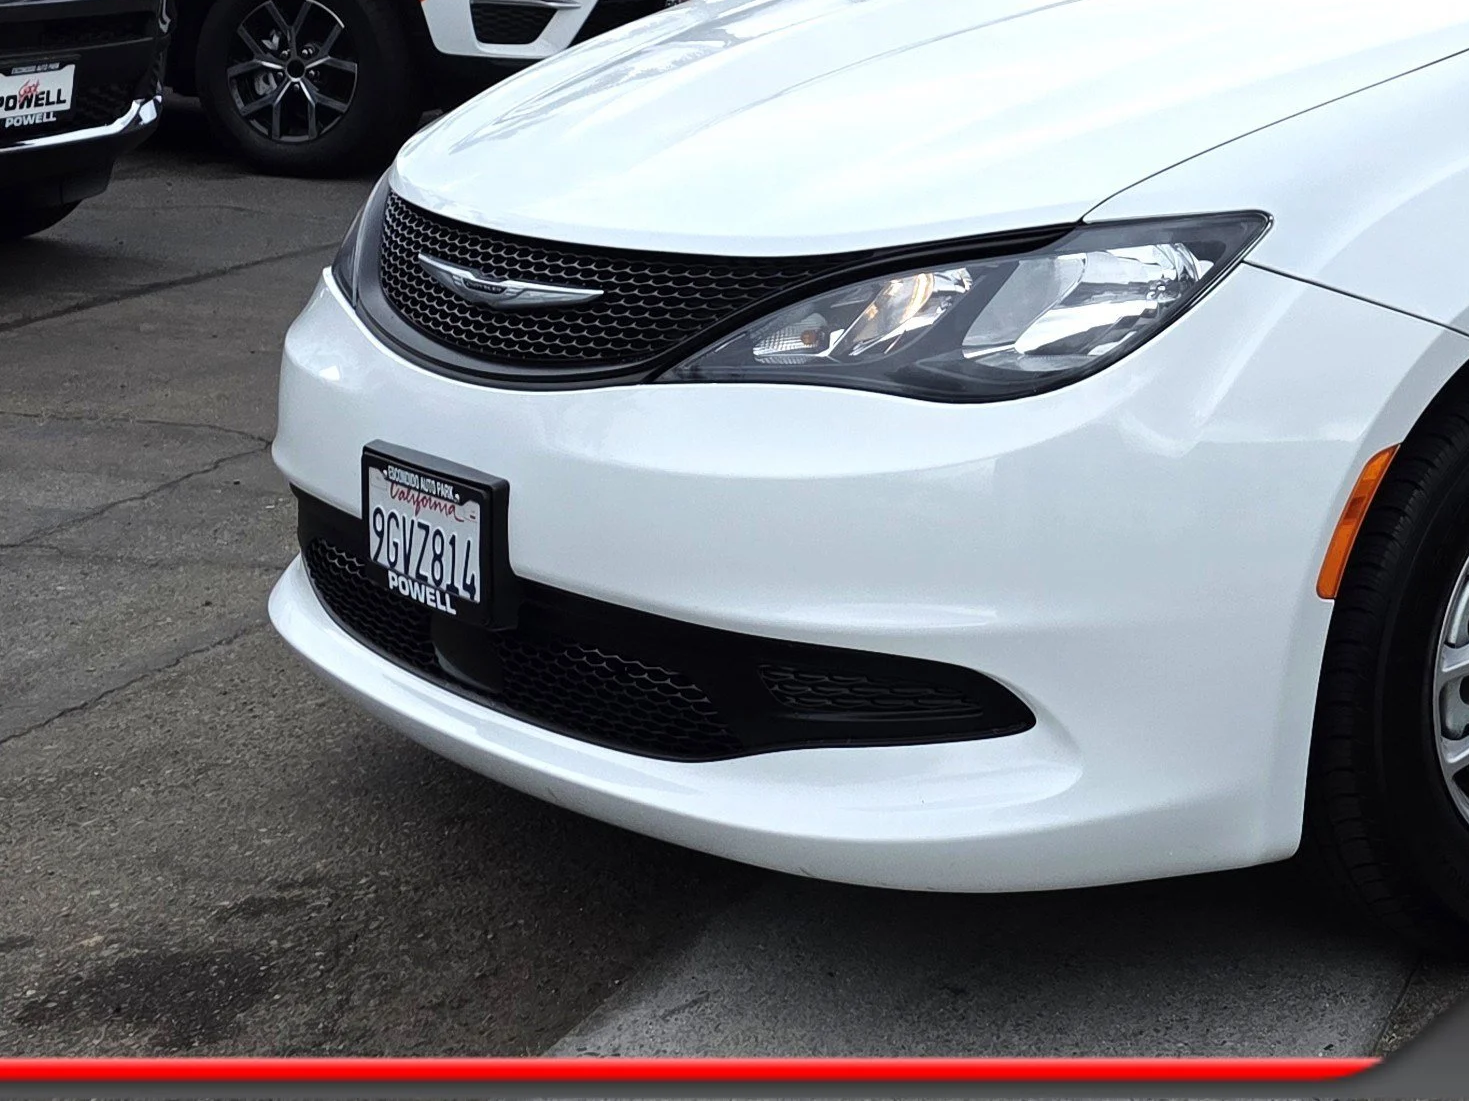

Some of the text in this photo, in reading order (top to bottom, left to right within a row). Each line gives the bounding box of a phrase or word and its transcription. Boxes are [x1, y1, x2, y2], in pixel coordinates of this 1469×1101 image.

[5, 111, 57, 128] POWELL
[390, 481, 465, 523] California
[373, 506, 477, 600] 9GVZ814
[388, 570, 457, 615] POWELL
